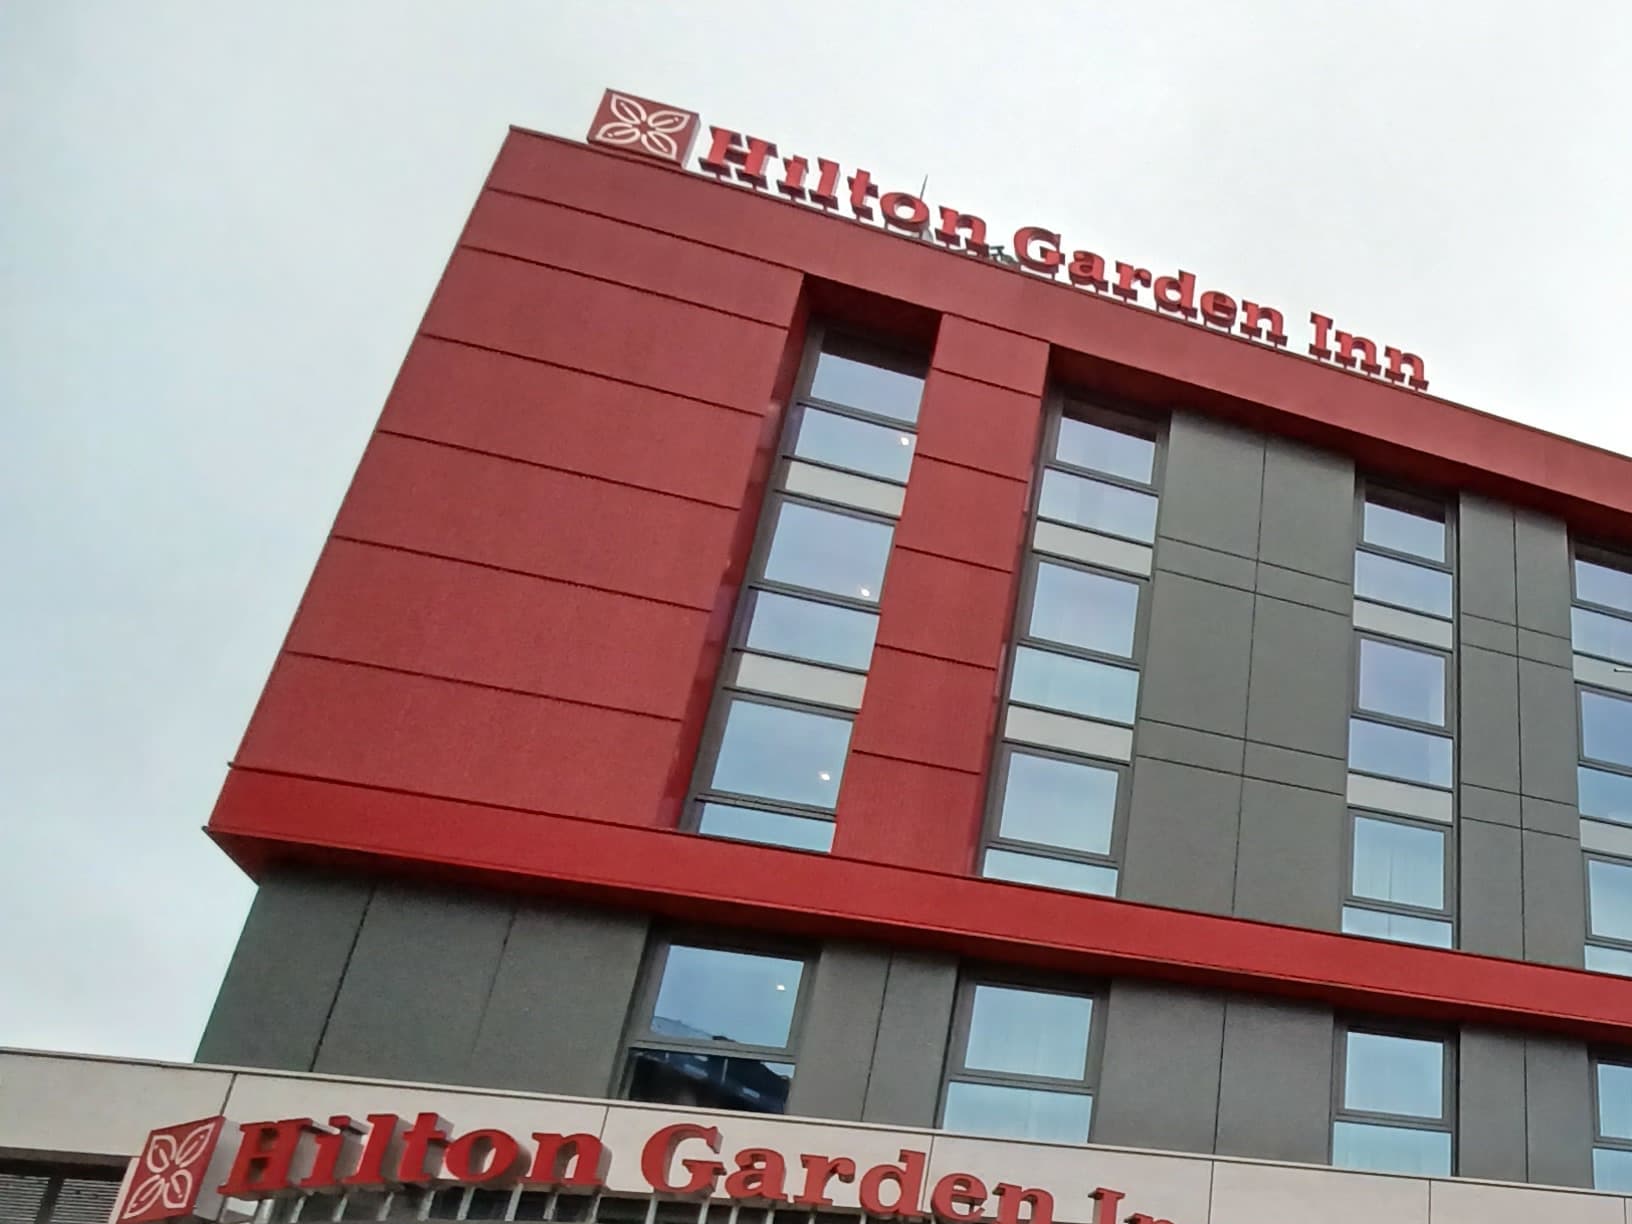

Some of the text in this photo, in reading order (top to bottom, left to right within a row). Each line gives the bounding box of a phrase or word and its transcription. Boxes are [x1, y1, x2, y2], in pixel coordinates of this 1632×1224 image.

[697, 126, 1431, 392] Hilton Garden Inn
[218, 1111, 606, 1201] Hilton
